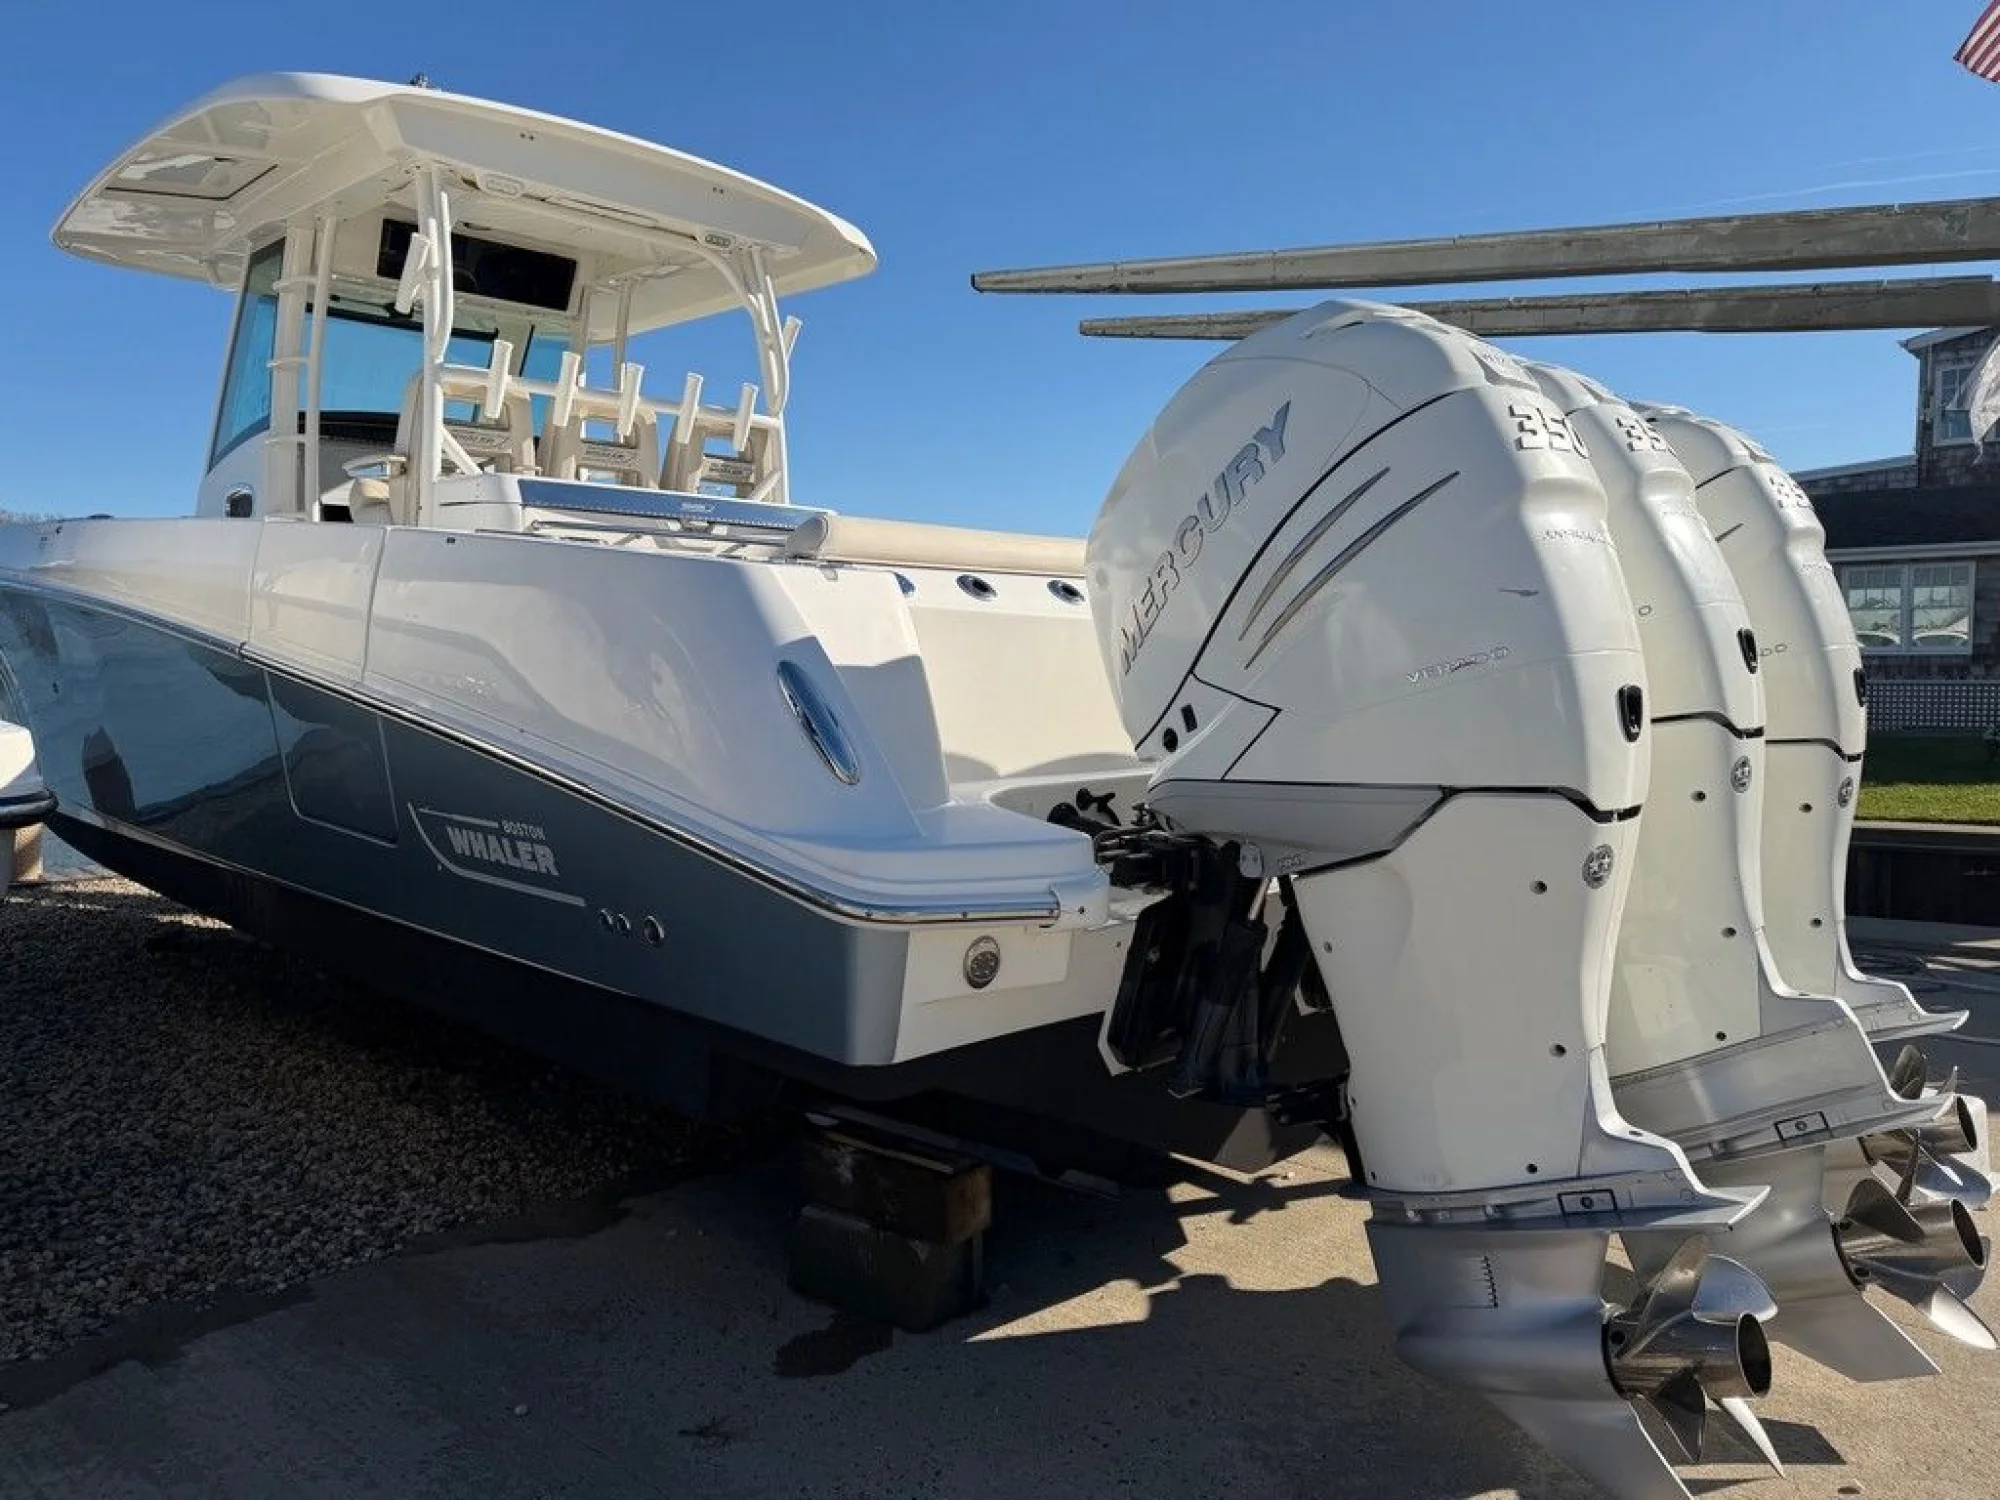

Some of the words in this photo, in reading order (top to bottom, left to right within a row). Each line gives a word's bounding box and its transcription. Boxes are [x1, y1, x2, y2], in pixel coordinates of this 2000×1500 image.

[1616, 417, 1677, 458] 35
[1119, 400, 1291, 676] MERCURY
[446, 826, 559, 876] WHALER
[501, 819, 546, 840] BOSTON
